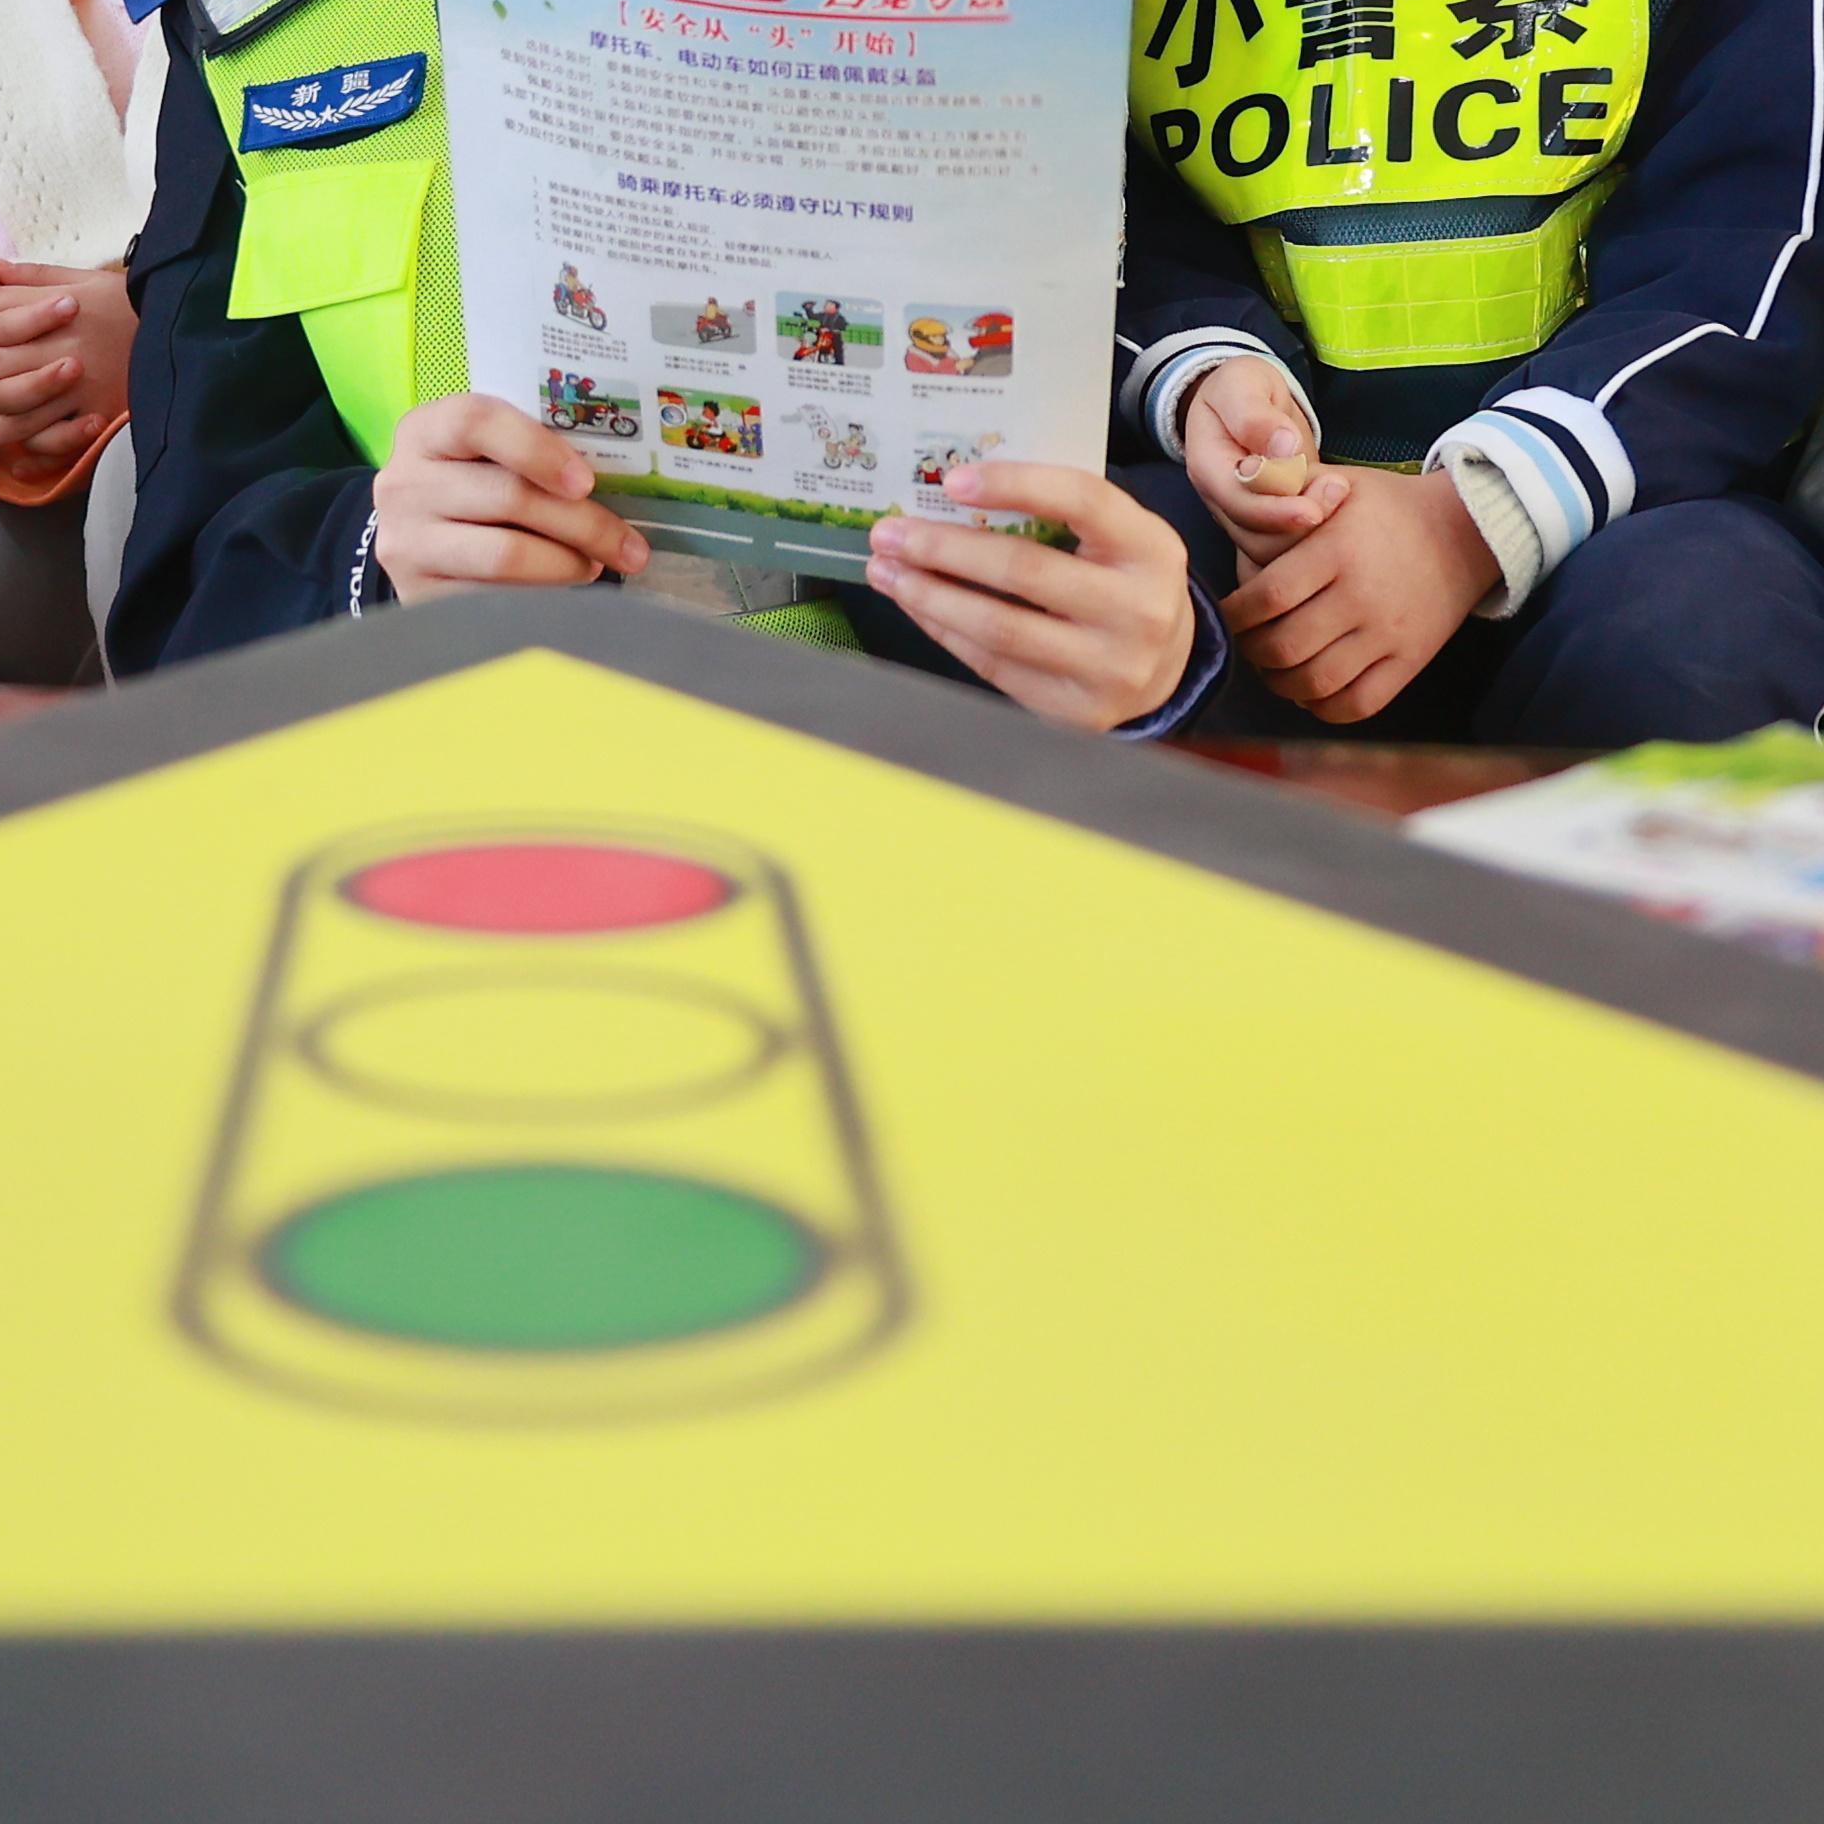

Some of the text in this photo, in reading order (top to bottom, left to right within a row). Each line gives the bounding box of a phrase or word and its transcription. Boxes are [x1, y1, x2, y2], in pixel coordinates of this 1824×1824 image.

[290, 69, 371, 108] 新疆
[1149, 68, 1612, 177] POLICE
[617, 171, 916, 224] 骑乘摩托车必须遵守以下规则
